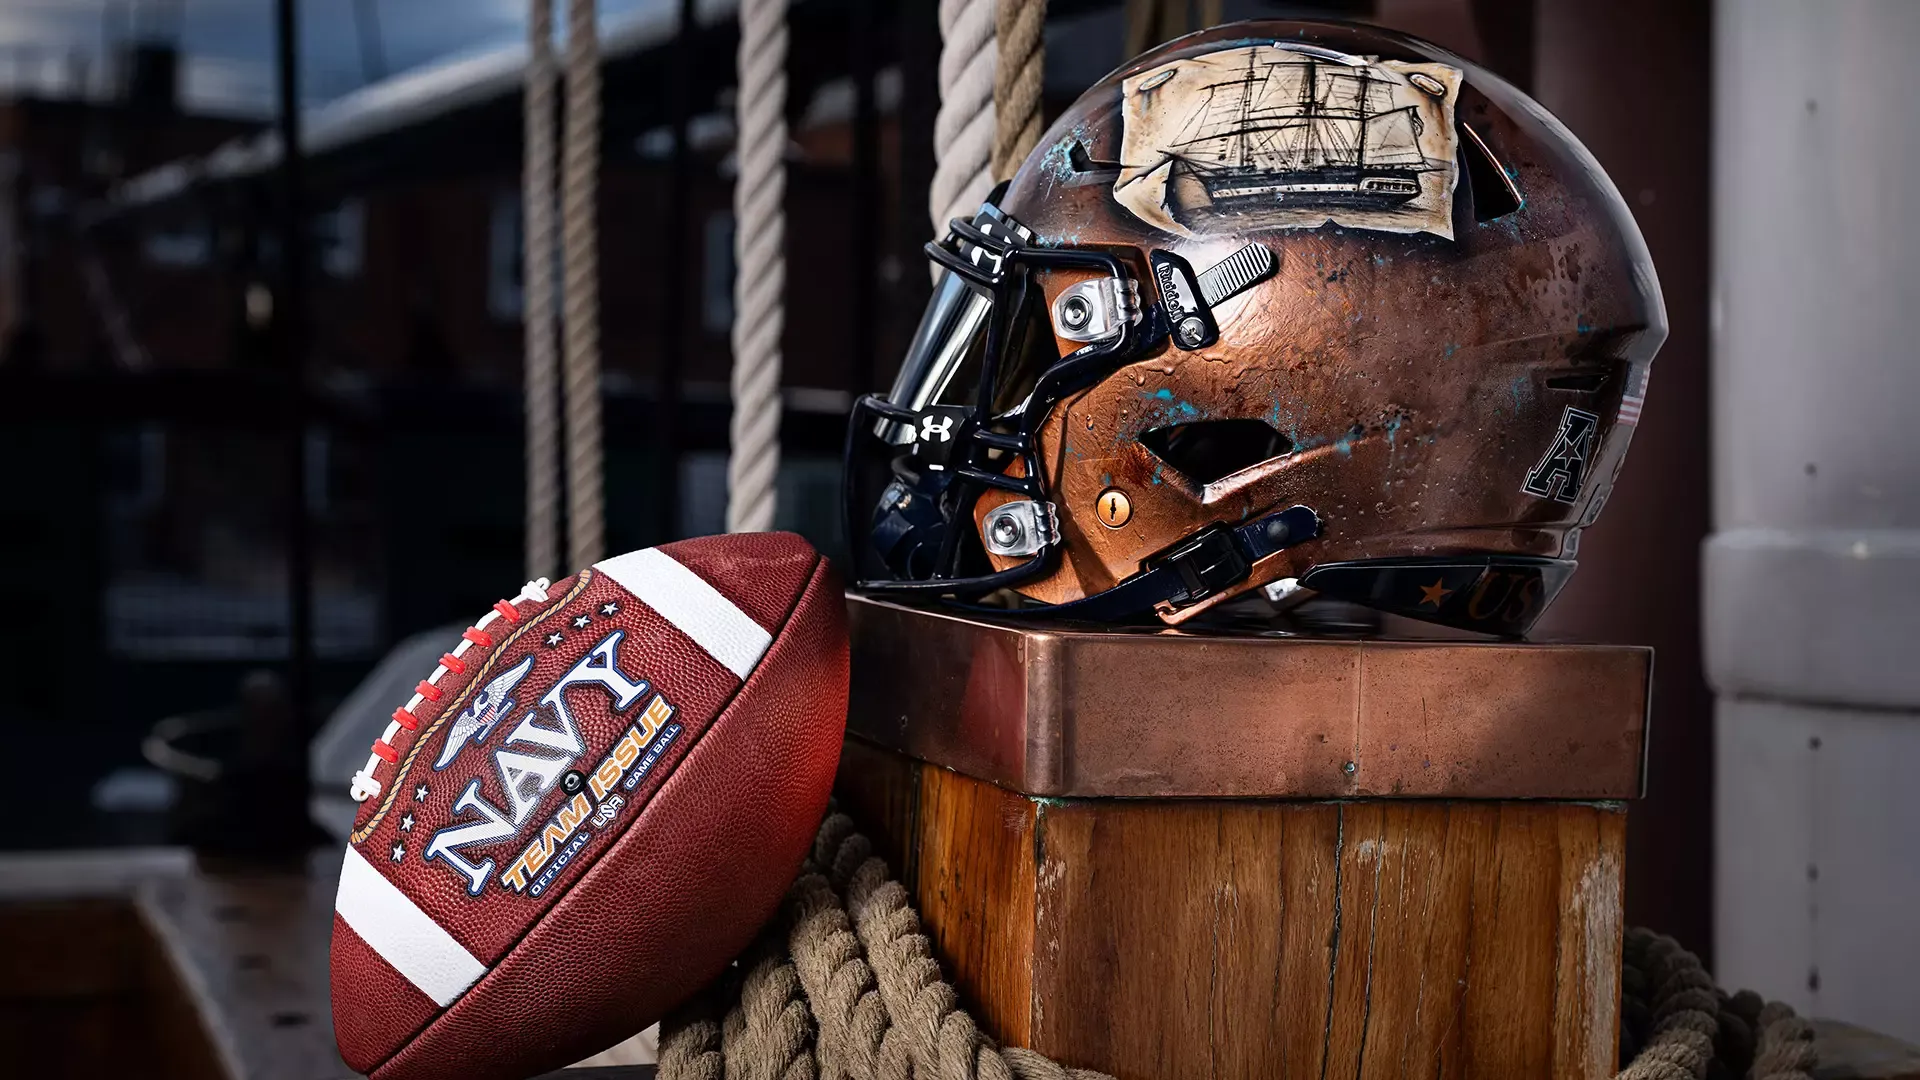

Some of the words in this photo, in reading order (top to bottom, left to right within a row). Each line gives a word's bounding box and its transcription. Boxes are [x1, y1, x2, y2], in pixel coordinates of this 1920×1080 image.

[1158, 263, 1185, 321] Riddell
[425, 630, 649, 895] NAVY
[501, 792, 592, 892] TEAM
[588, 694, 673, 802] ISSUE
[531, 832, 588, 895] OFFICIAL
[625, 754, 656, 789] GAME
[654, 725, 679, 754] BALL
